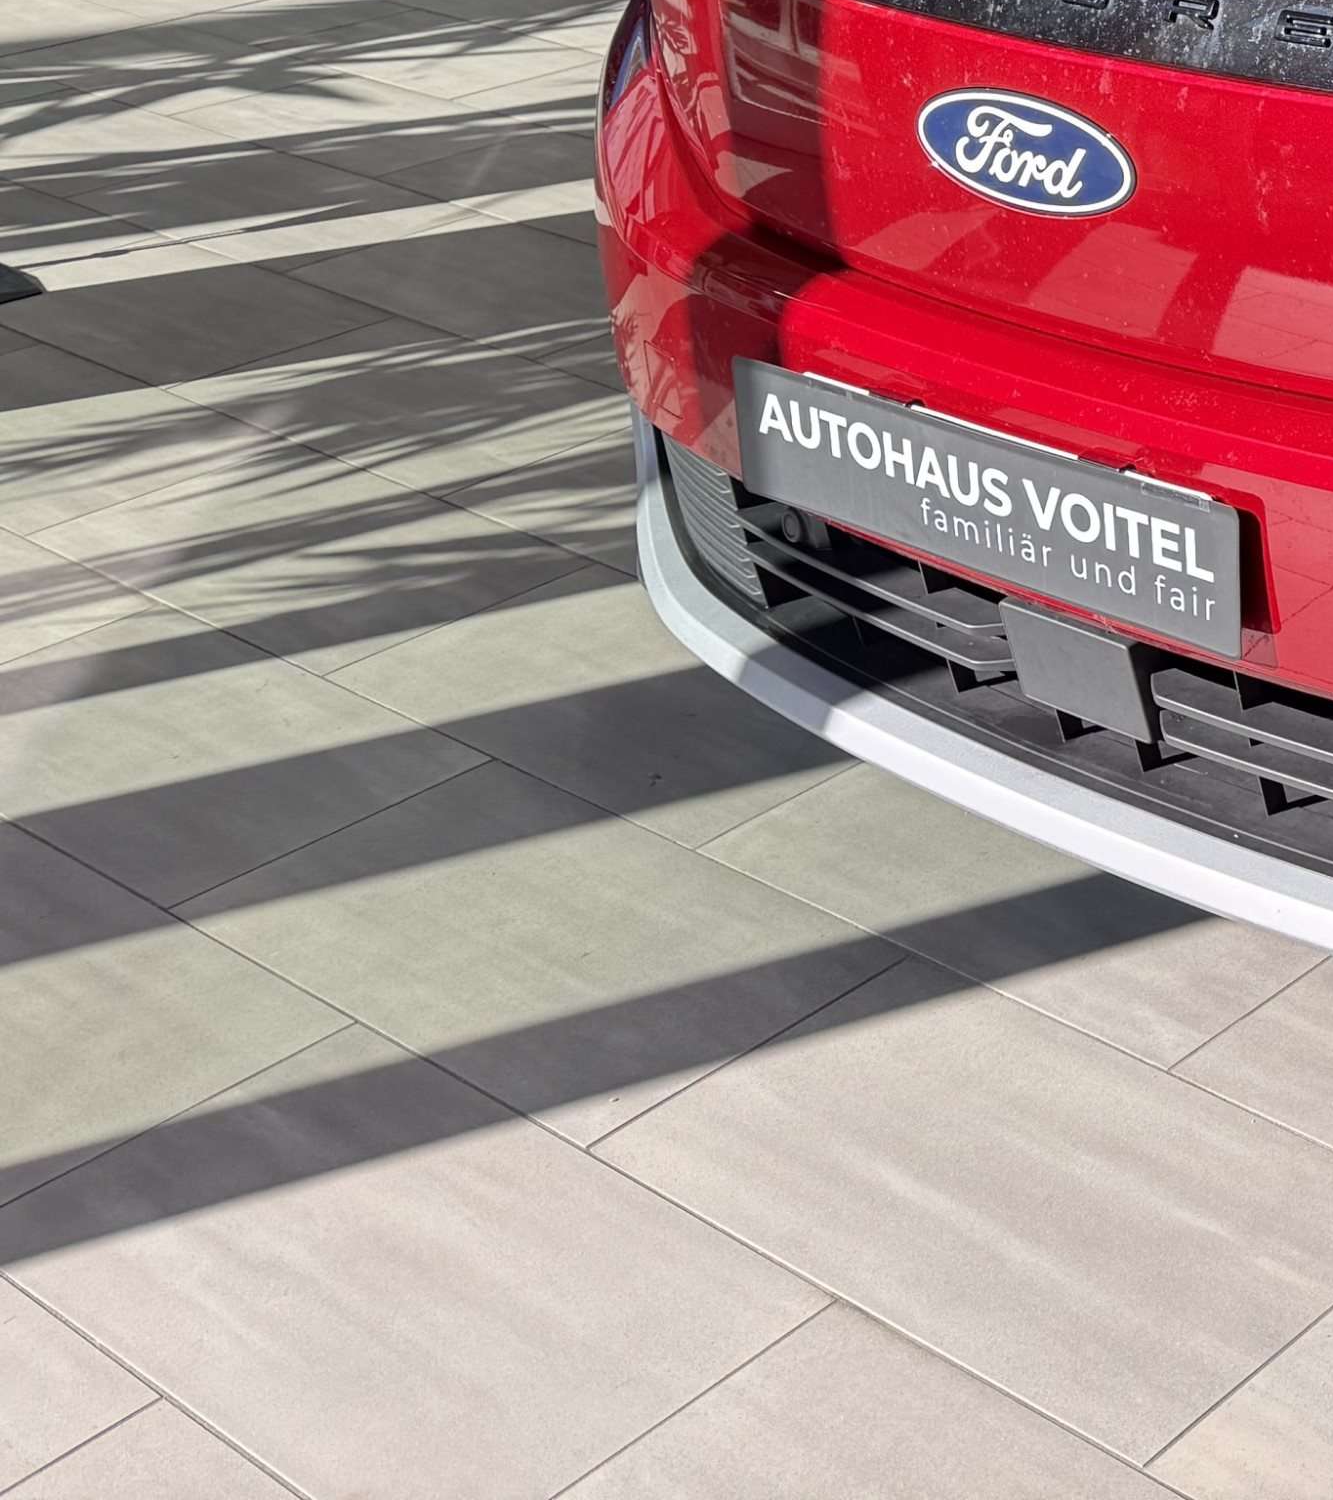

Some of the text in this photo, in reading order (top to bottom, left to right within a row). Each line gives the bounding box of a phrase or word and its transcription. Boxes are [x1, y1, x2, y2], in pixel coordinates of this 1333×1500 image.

[955, 105, 1087, 199] Ford
[758, 393, 1216, 584] AUTOHAUS VOITEL
[919, 498, 1217, 622] familiär und fair
